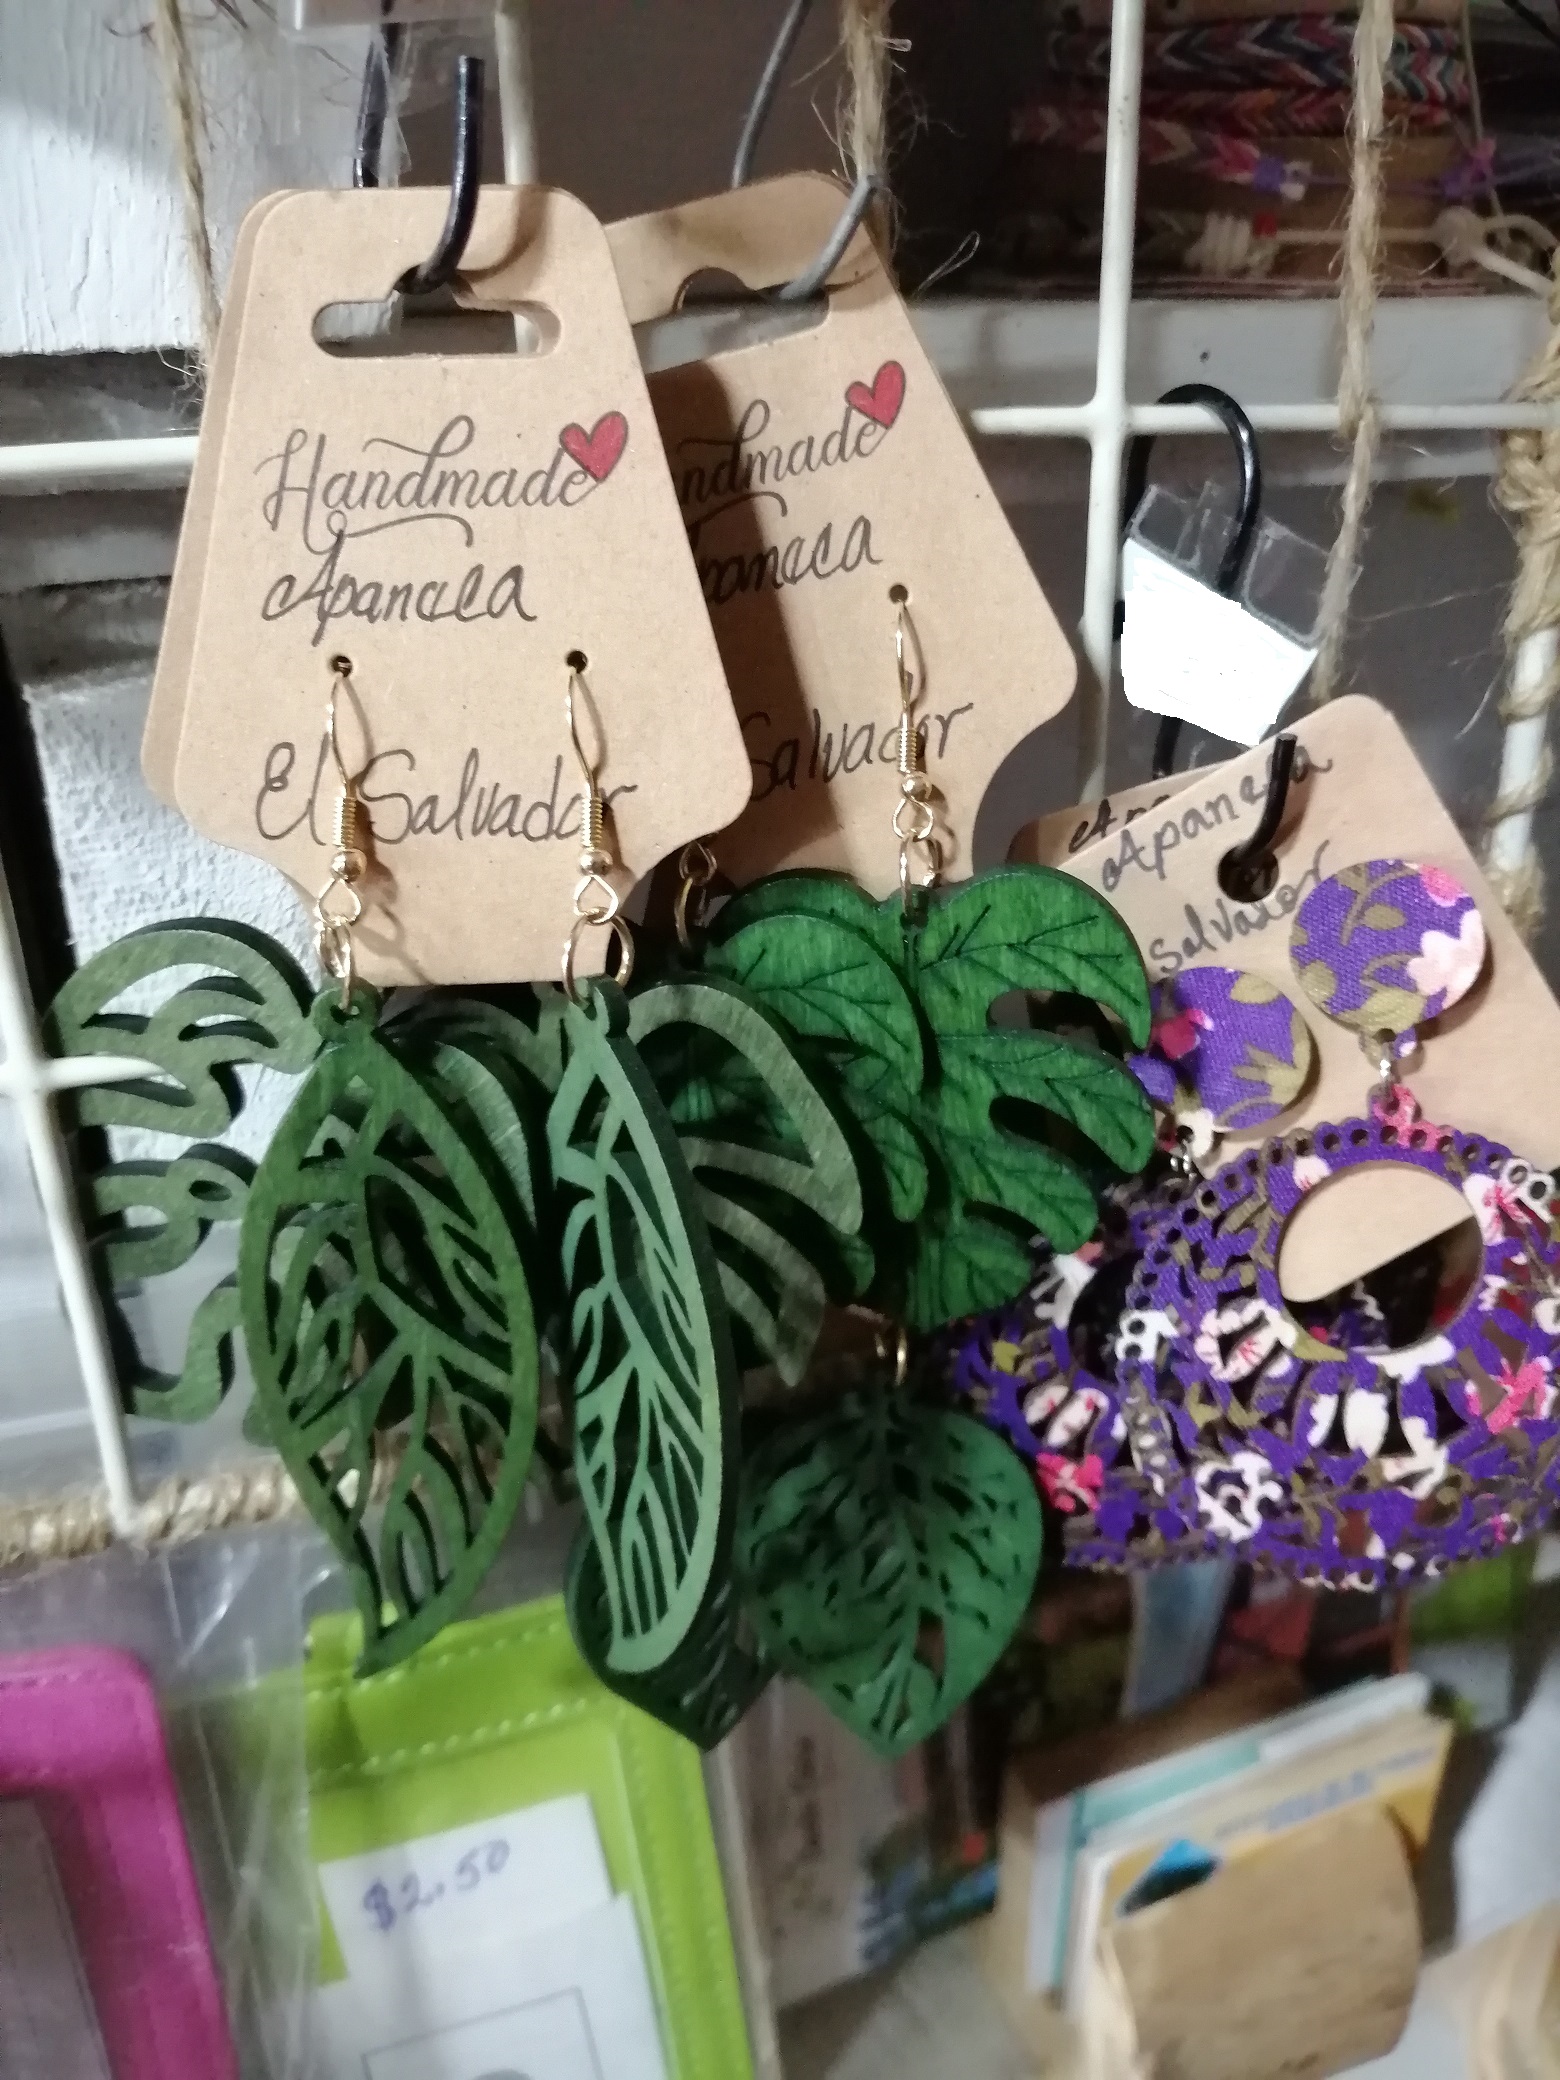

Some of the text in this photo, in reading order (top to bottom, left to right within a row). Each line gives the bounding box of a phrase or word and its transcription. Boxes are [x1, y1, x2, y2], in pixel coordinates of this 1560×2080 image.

[253, 414, 602, 556] Handmade
[671, 398, 892, 528] ndmade
[697, 514, 882, 605] paneca
[255, 731, 639, 846] El Salvador
[1101, 744, 1334, 892] Apanea
[361, 1836, 512, 1934] $2.50
